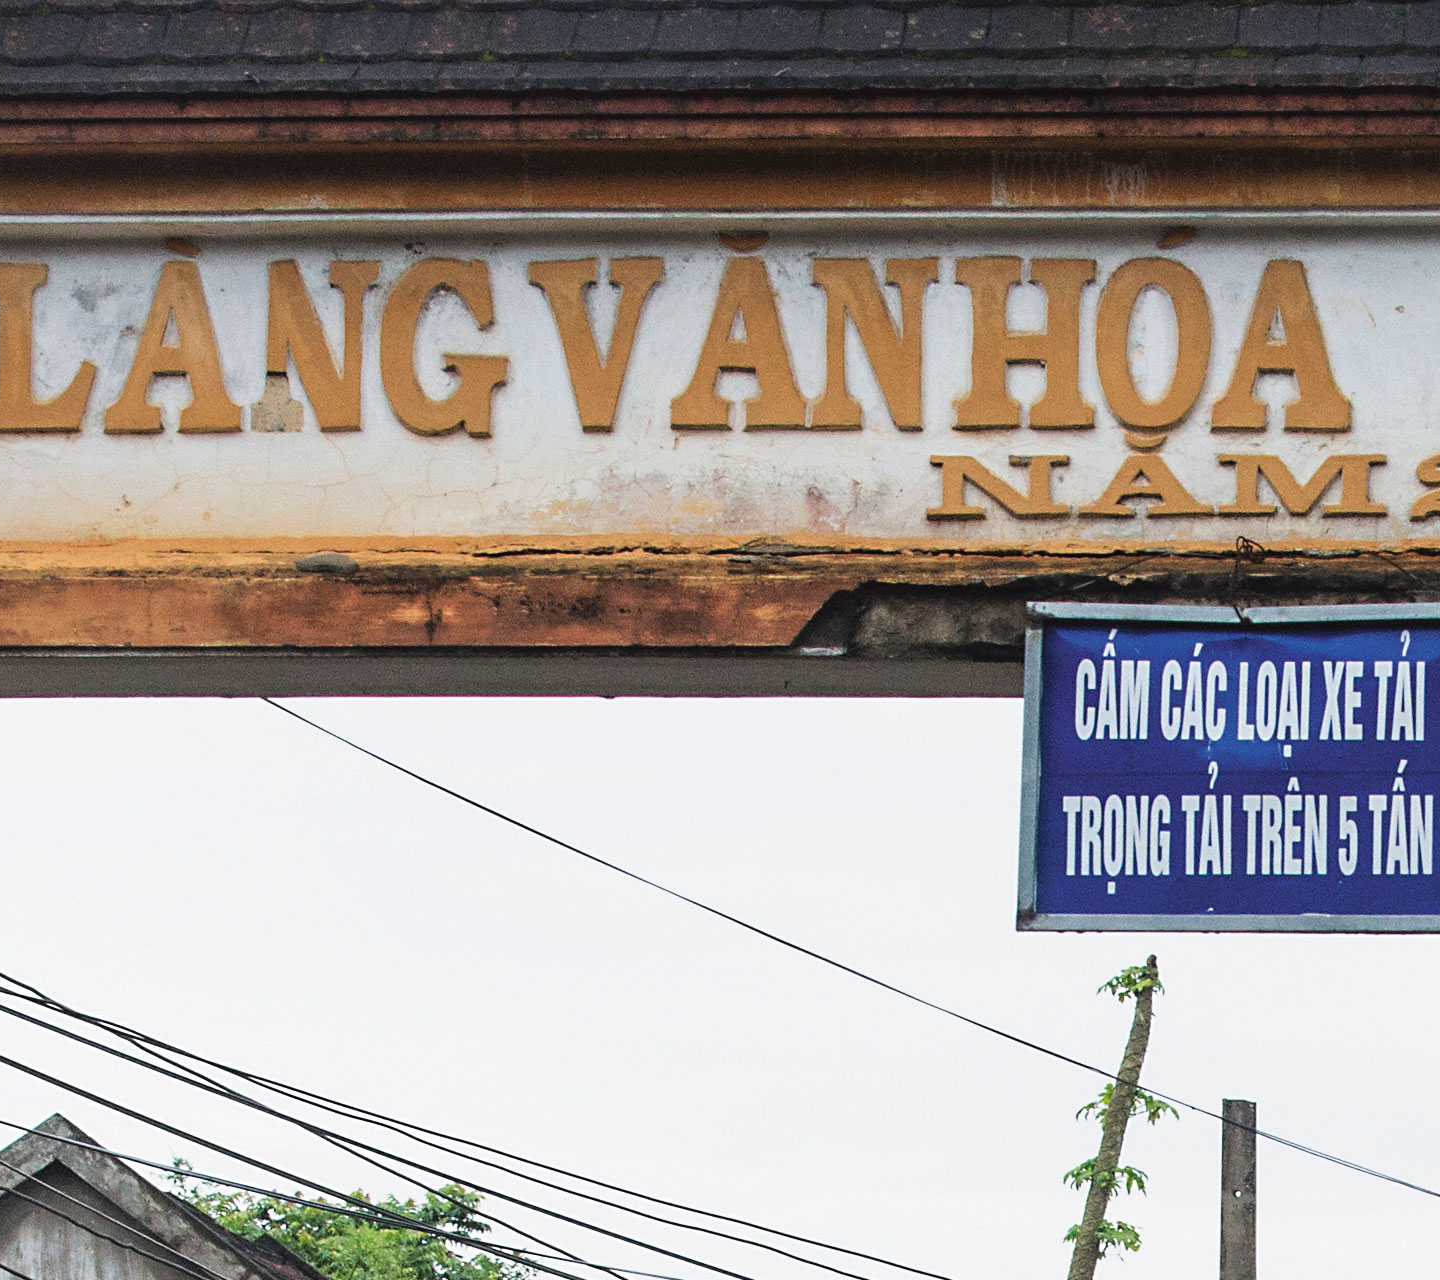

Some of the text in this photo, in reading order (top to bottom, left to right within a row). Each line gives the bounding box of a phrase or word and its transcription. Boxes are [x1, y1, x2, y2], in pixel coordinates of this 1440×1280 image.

[528, 229, 940, 432] VĂN
[926, 433, 1388, 521] NĂM
[1075, 628, 1426, 758] CẤM CÁC LOẠI XE TẢI
[1062, 760, 1434, 895] TRỌNG TẢI TRÊN 5 TẤN
